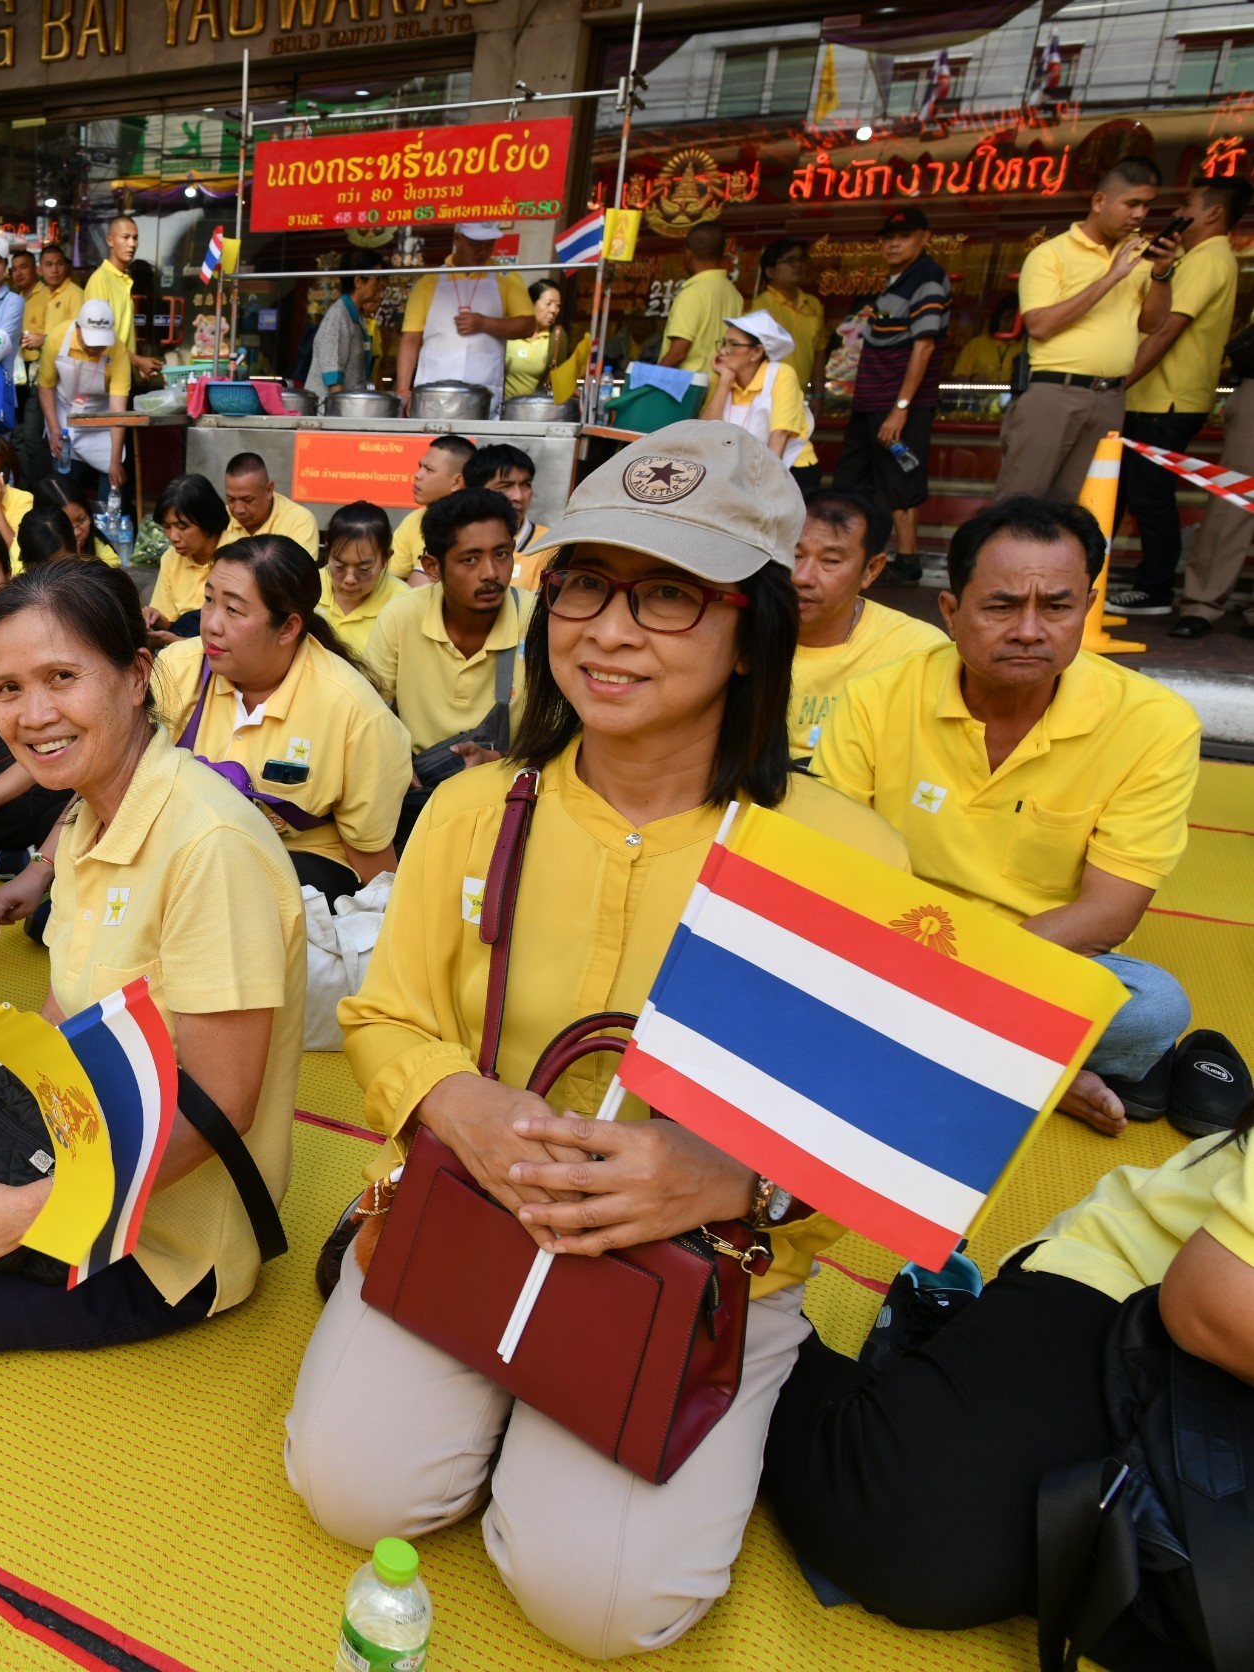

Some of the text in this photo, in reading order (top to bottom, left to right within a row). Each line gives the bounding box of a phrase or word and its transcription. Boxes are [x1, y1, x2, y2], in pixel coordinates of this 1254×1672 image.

[40, 0, 125, 63] BAI
[270, 33, 320, 55] GOLD
[326, 25, 387, 48] SMITH
[266, 130, 550, 187] แกงกระหรี่นายโย่ง
[789, 143, 1072, 199] สำนักงานใหญ่
[371, 187, 393, 202] 80
[403, 183, 464, 201] ปีเยาวราช
[288, 211, 324, 226] จานละ
[387, 207, 411, 222] บาท
[414, 206, 435, 220] 65
[633, 480, 681, 496] ALL STAR
[798, 695, 838, 725] MA
